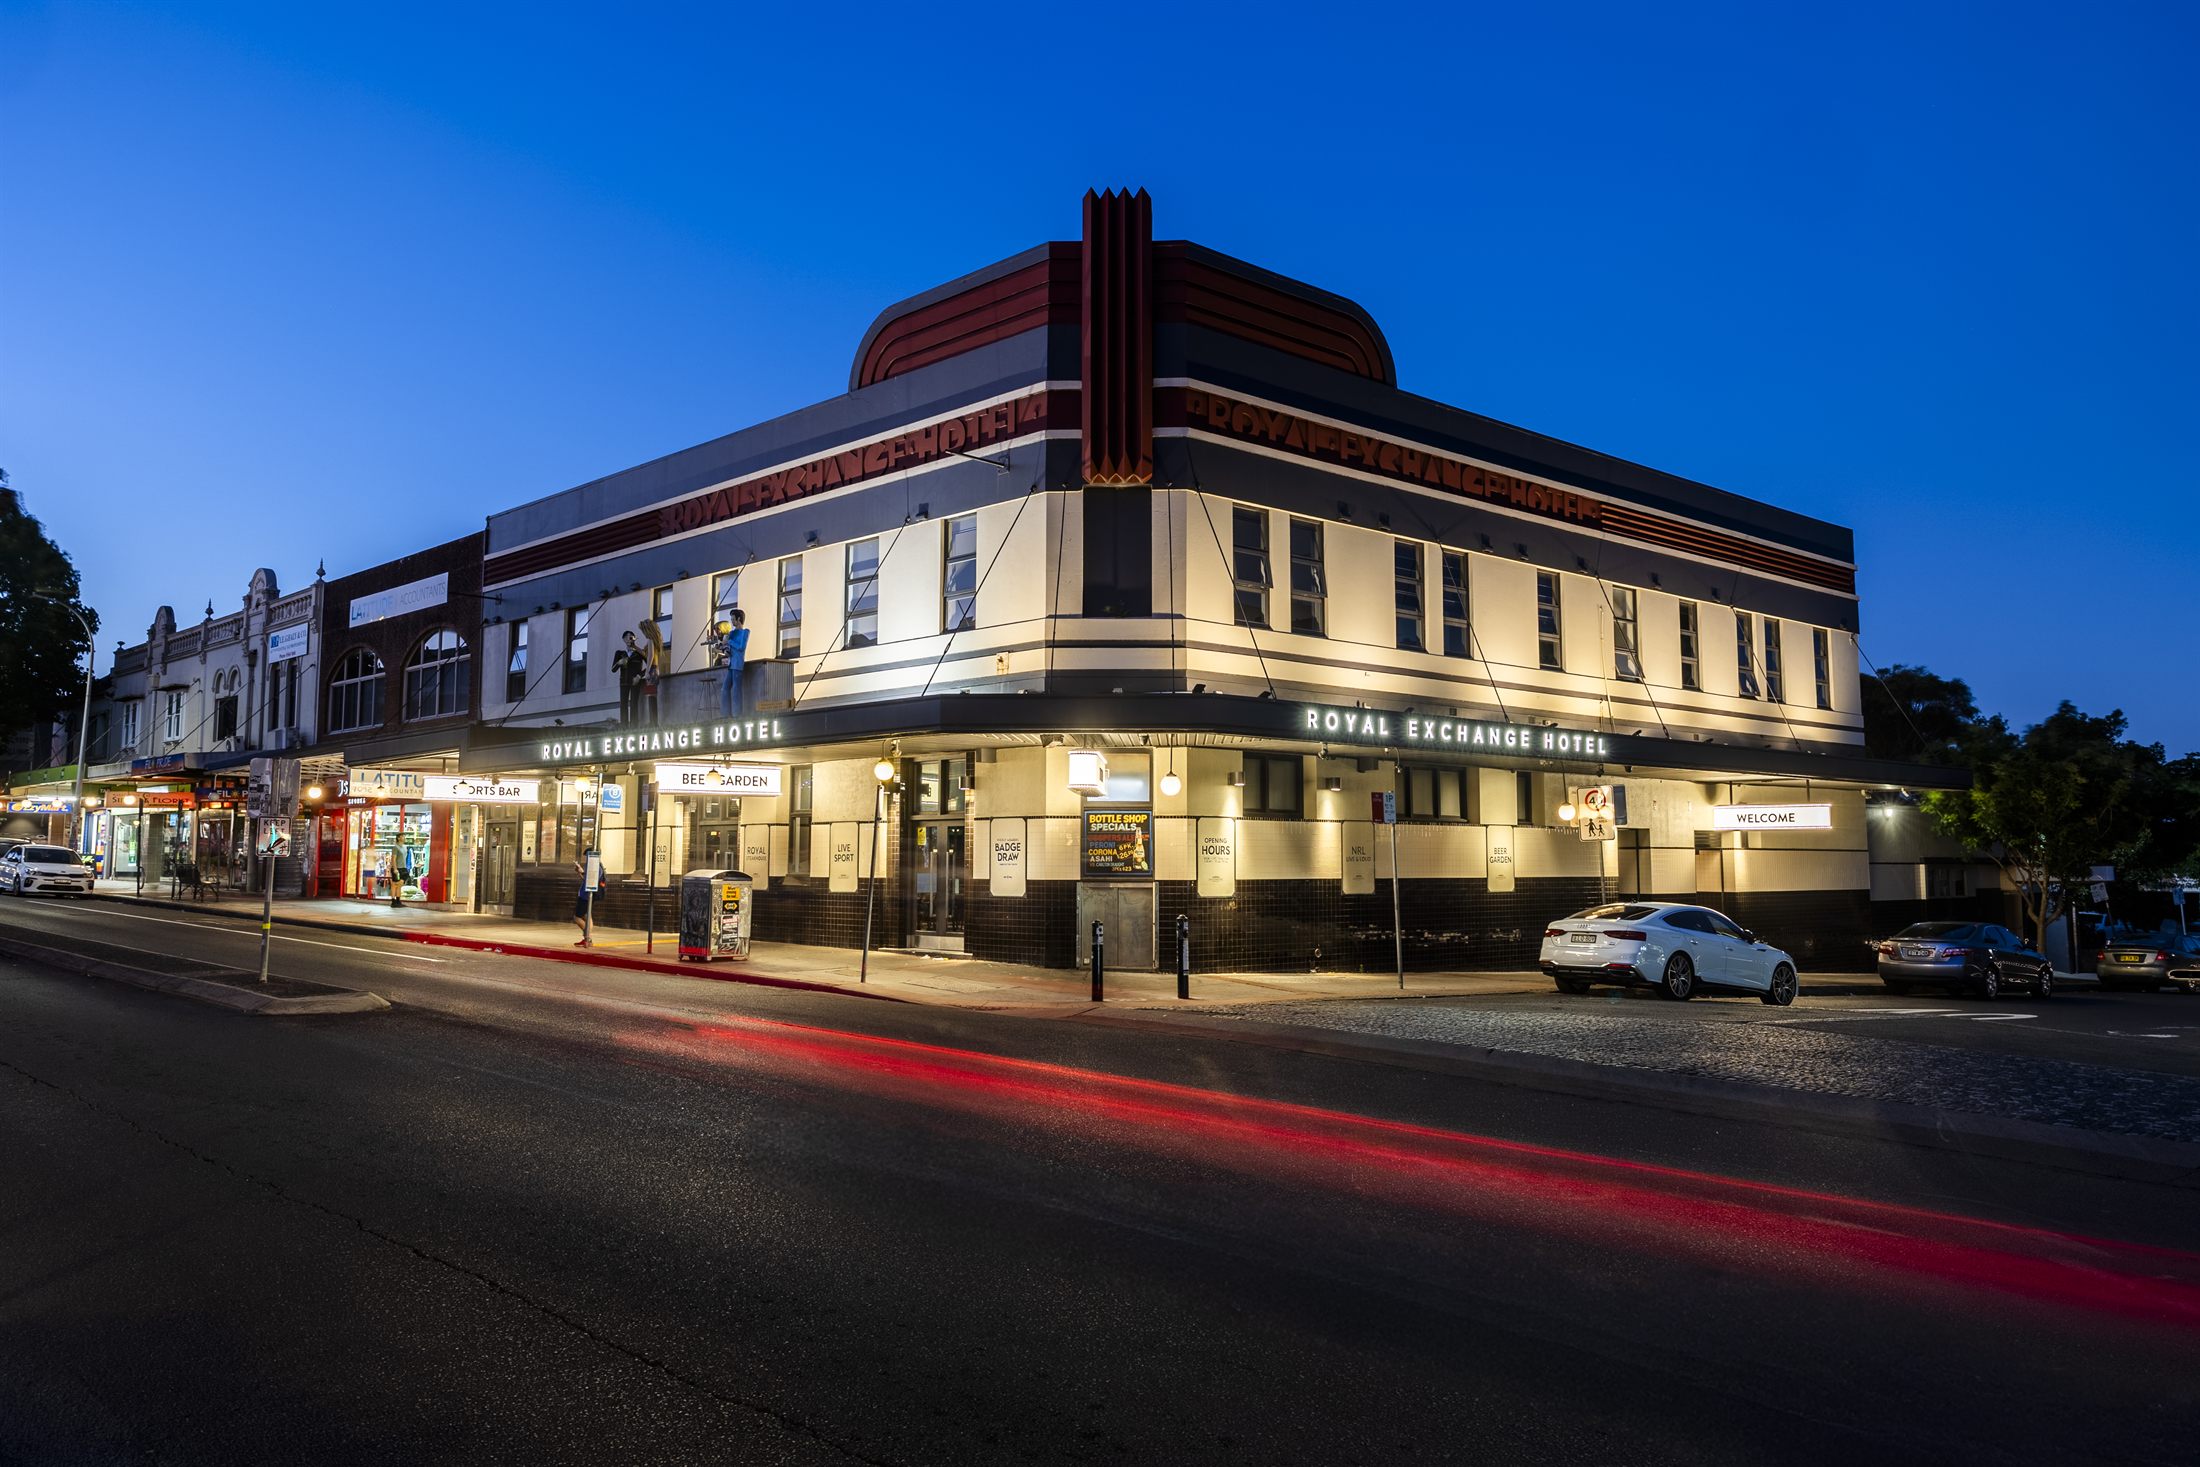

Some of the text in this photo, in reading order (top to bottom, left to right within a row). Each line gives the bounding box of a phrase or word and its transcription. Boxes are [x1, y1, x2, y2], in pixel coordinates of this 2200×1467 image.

[1307, 710, 1607, 754] ROYAL EXCHANGE HOTEL
[542, 720, 782, 760] ROYAL EXCHANGE HOTEL
[682, 773, 705, 785] BEE
[453, 784, 521, 796] SORTS BAR
[1089, 814, 1148, 823] BOTTLE SHOP
[1737, 812, 1796, 823] WELCOME
[1091, 823, 1137, 831] SPECIALS
[656, 845, 667, 853] OLD
[837, 843, 850, 852] LIVE
[994, 842, 1021, 851] BADGE
[1089, 841, 1115, 849] PERONI
[747, 846, 766, 855] ROYAL
[1088, 848, 1118, 856] CORONA
[1201, 845, 1231, 855] HOURS
[1351, 845, 1366, 855] NRL
[656, 854, 667, 863] EER
[833, 853, 854, 862] SPORT
[997, 852, 1019, 861] DRAW
[1489, 855, 1512, 863] GARDEN
